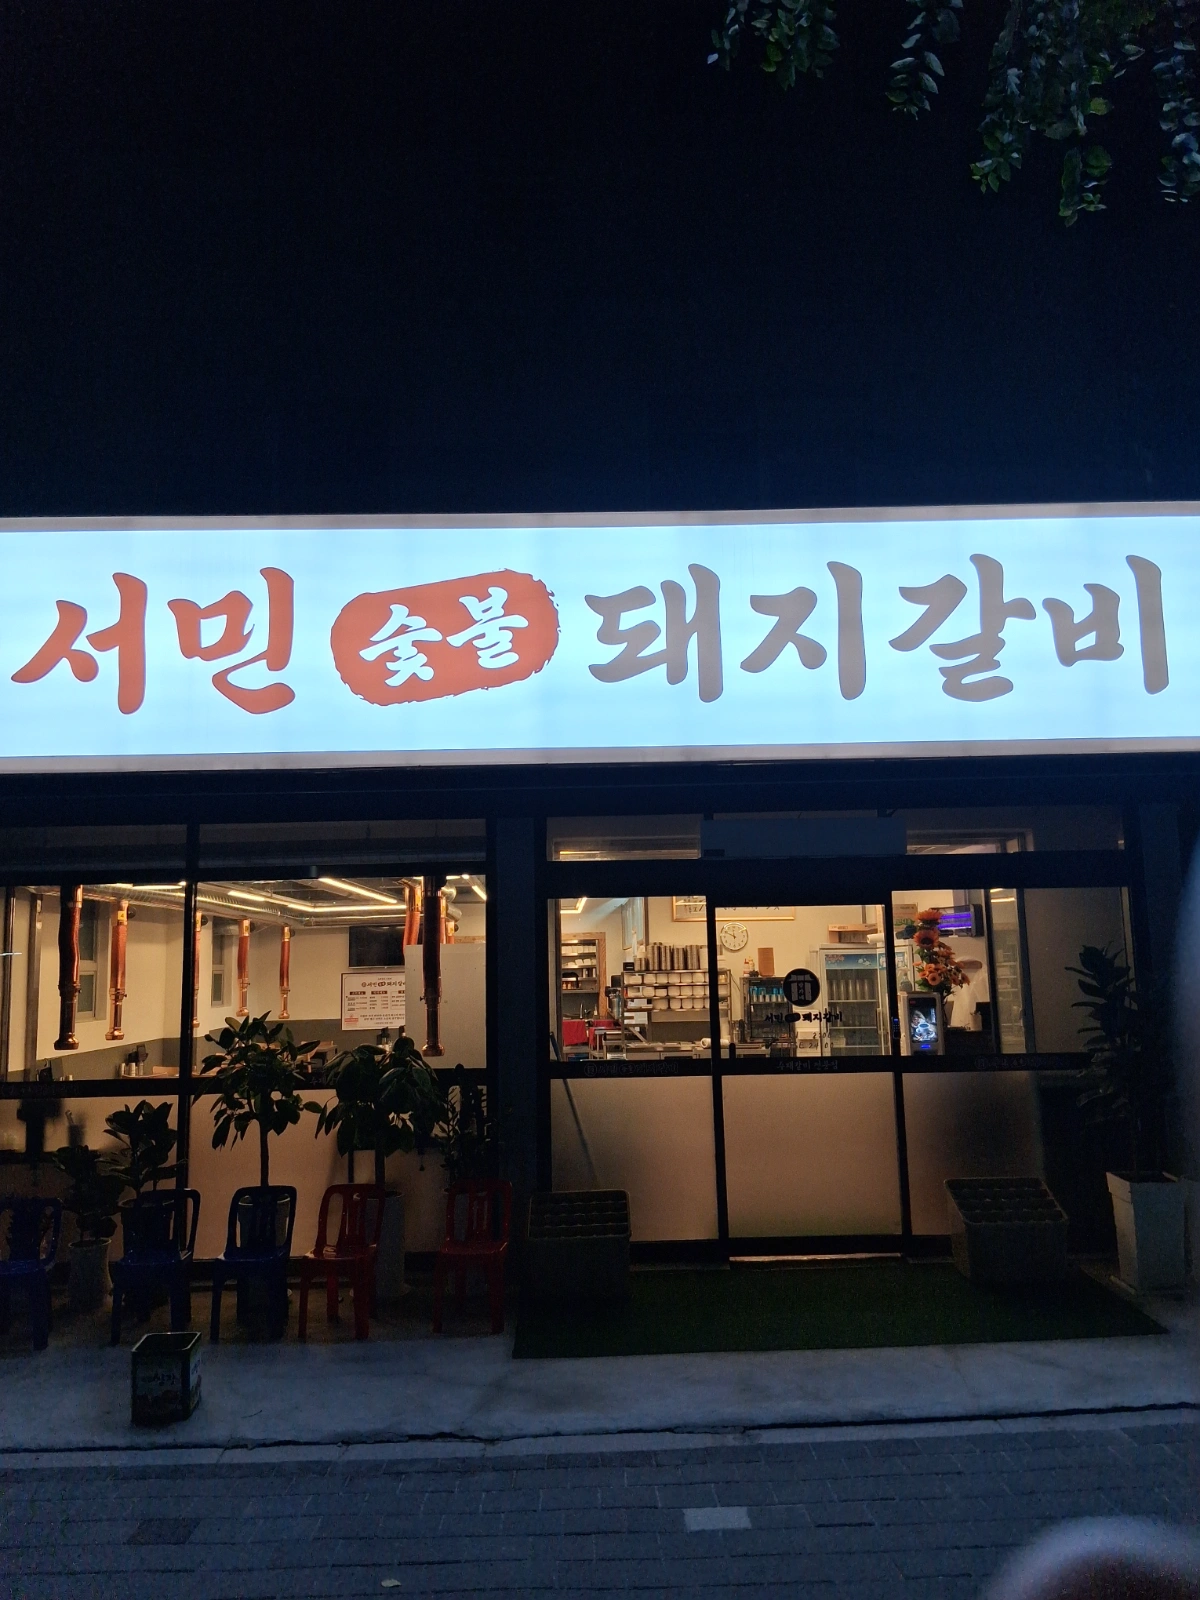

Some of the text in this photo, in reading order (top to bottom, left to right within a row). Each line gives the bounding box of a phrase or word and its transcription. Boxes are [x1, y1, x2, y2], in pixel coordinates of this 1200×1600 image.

[11, 553, 1169, 714] 서민 숯불 돼지갈비
